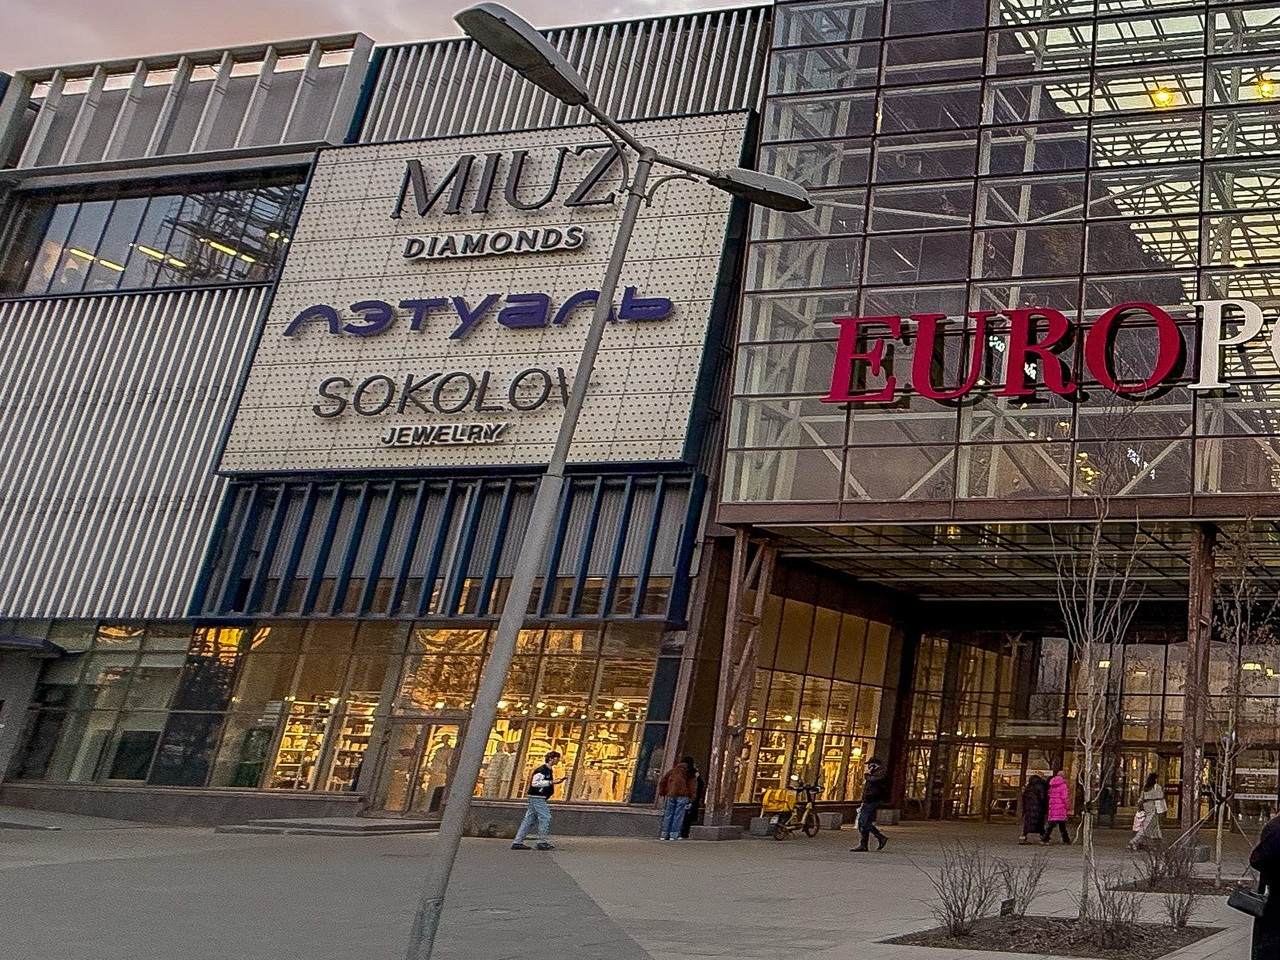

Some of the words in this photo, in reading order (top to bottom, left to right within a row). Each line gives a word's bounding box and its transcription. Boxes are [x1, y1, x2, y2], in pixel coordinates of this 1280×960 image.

[389, 142, 626, 219] MIUZ
[403, 226, 588, 259] DIAMONDS
[381, 422, 508, 446] JEWELRY
